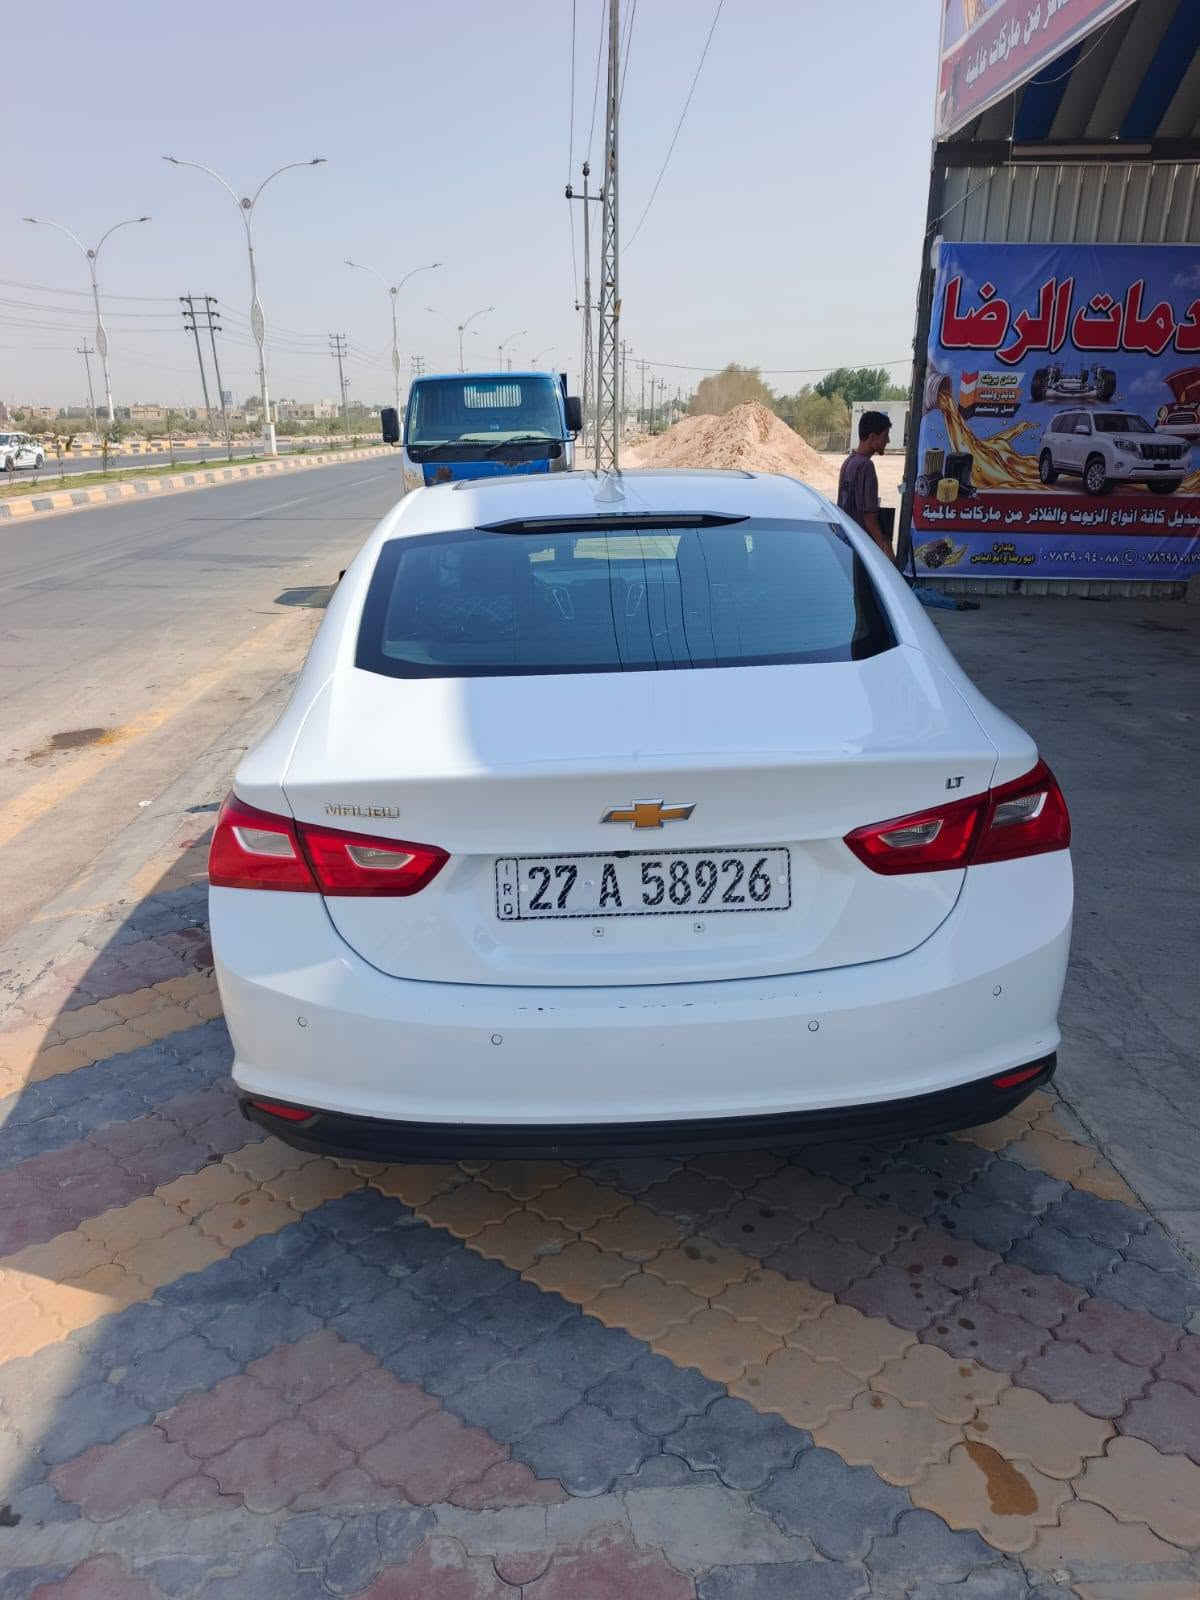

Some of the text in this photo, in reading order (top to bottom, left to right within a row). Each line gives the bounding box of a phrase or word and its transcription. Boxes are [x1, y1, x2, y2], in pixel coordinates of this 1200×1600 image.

[941, 276, 1200, 363] دمات الرضا
[923, 504, 957, 522] عالمية
[960, 506, 1002, 522] ماركات
[1005, 510, 1023, 523] من
[1070, 508, 1108, 525] الزيوت
[1141, 508, 1165, 523] كافة
[1168, 509, 1200, 527] بديل
[946, 776, 964, 789] LT
[327, 805, 400, 819] MALIBU
[528, 858, 771, 910] 27 A 58926
